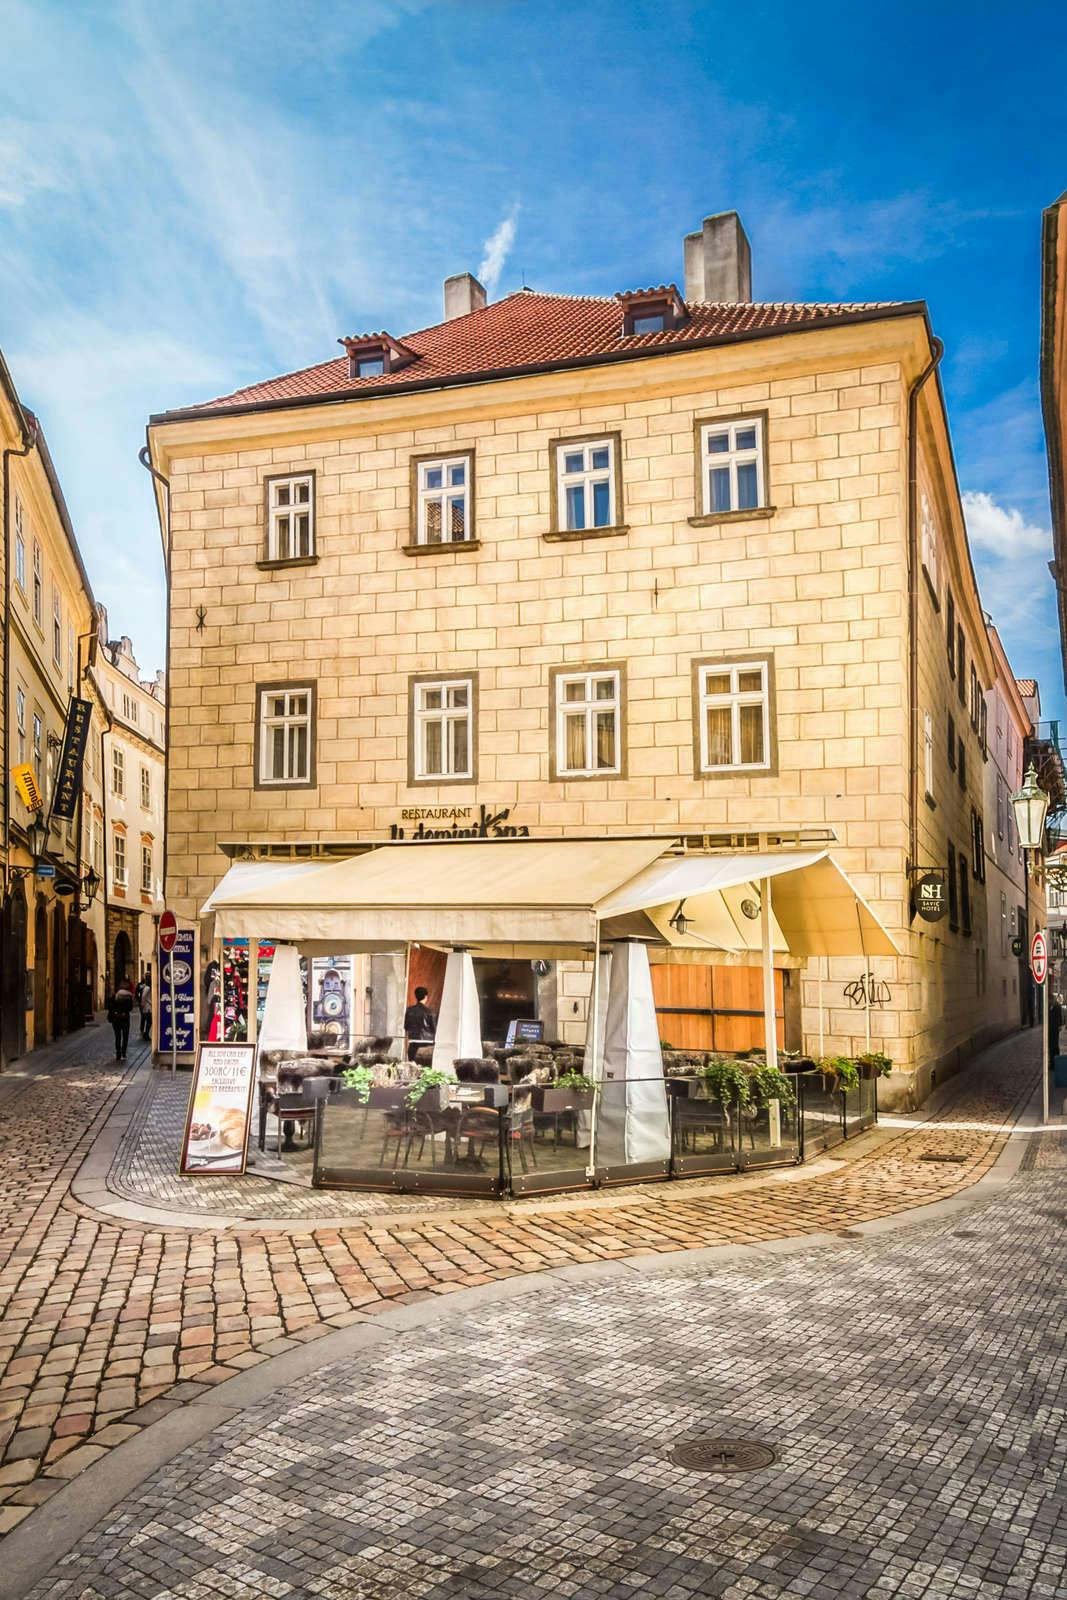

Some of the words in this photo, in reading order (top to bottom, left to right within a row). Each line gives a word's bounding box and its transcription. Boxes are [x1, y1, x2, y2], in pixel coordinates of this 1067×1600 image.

[61, 703, 86, 812] RESTAURANT
[22, 771, 39, 804] TATTOO
[402, 808, 472, 820] RESTAURANT
